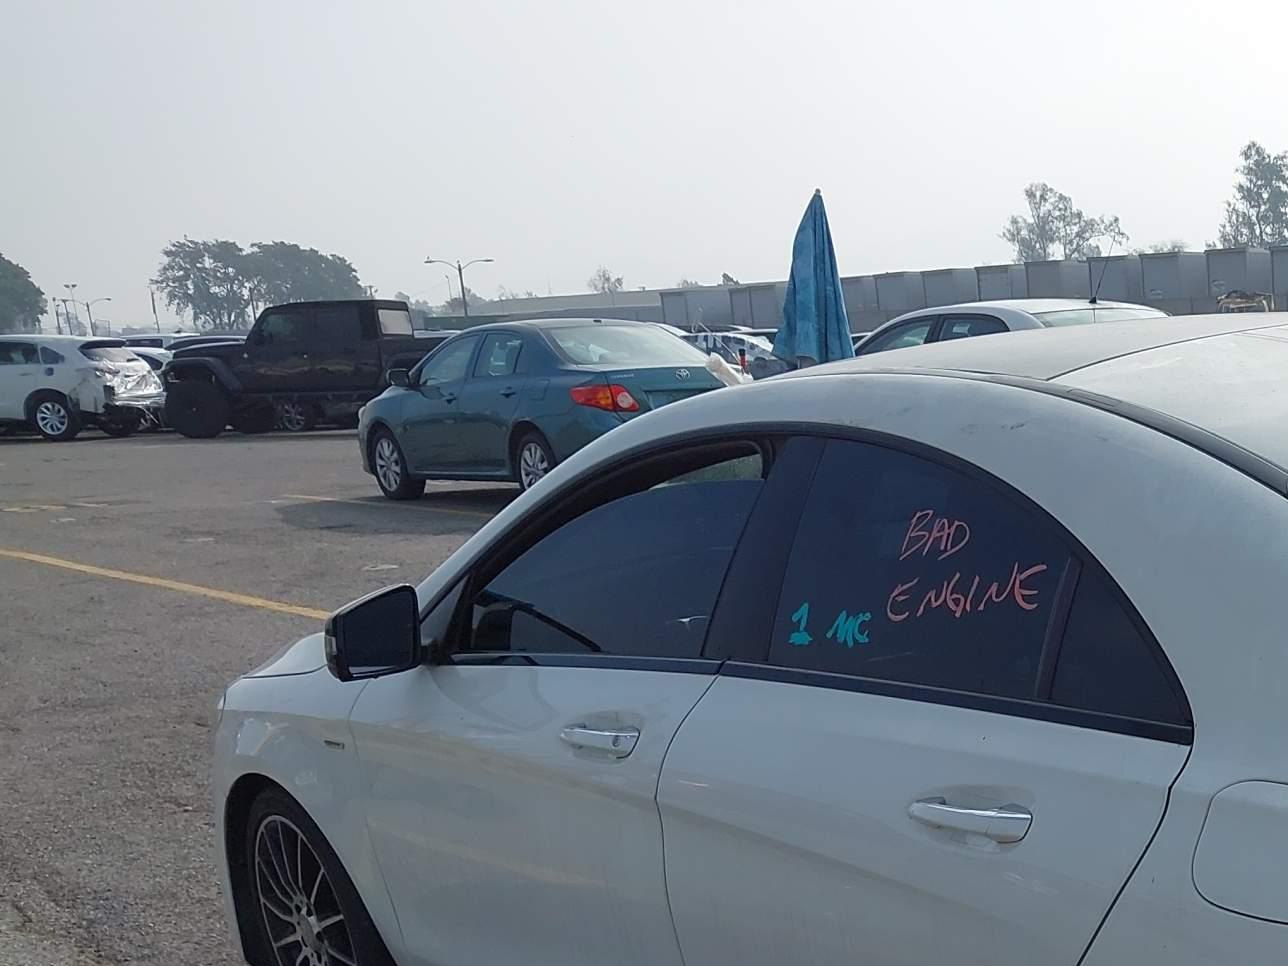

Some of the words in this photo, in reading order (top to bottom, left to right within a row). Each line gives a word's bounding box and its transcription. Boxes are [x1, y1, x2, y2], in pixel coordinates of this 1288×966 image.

[900, 509, 970, 560] BAD
[887, 562, 1047, 621] ENGINE
[788, 602, 813, 645] 1
